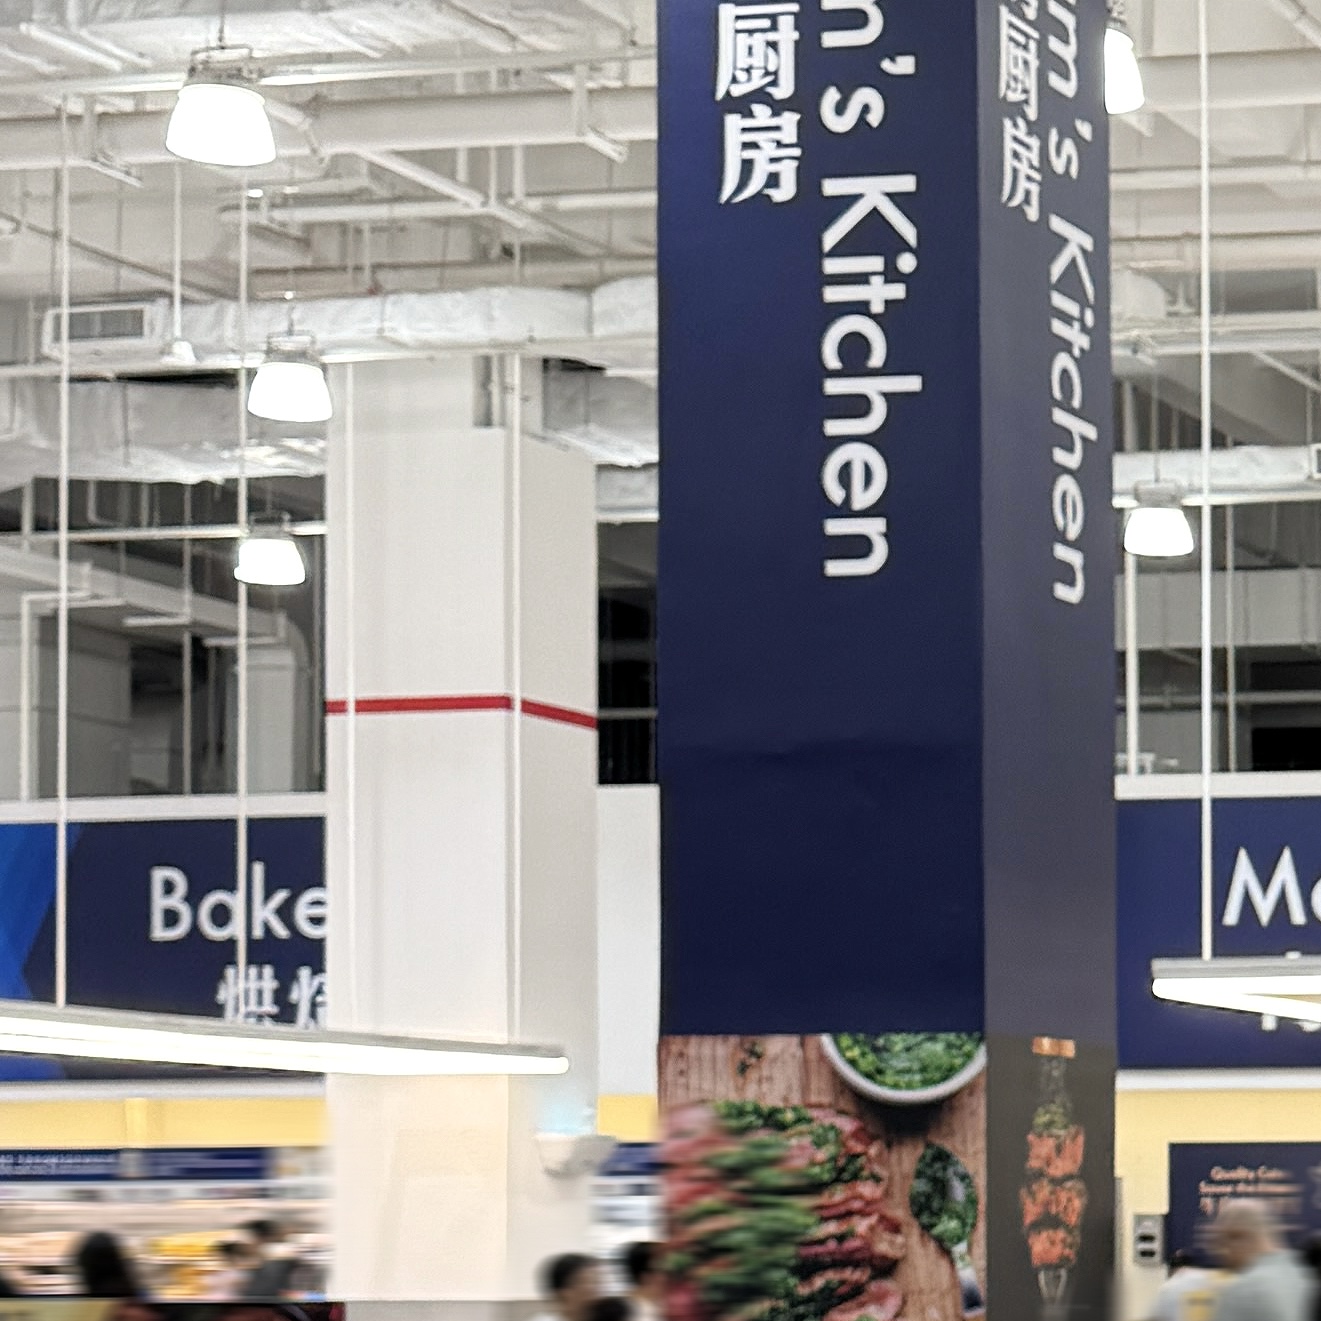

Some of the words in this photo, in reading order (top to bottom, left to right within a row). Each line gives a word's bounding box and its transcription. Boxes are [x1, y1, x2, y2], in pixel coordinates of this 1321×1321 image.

[714, 3, 802, 204] 厨房
[999, 0, 1042, 222] 厨房
[821, 174, 923, 577] Kitchen
[1048, 213, 1098, 605] Kitchen
